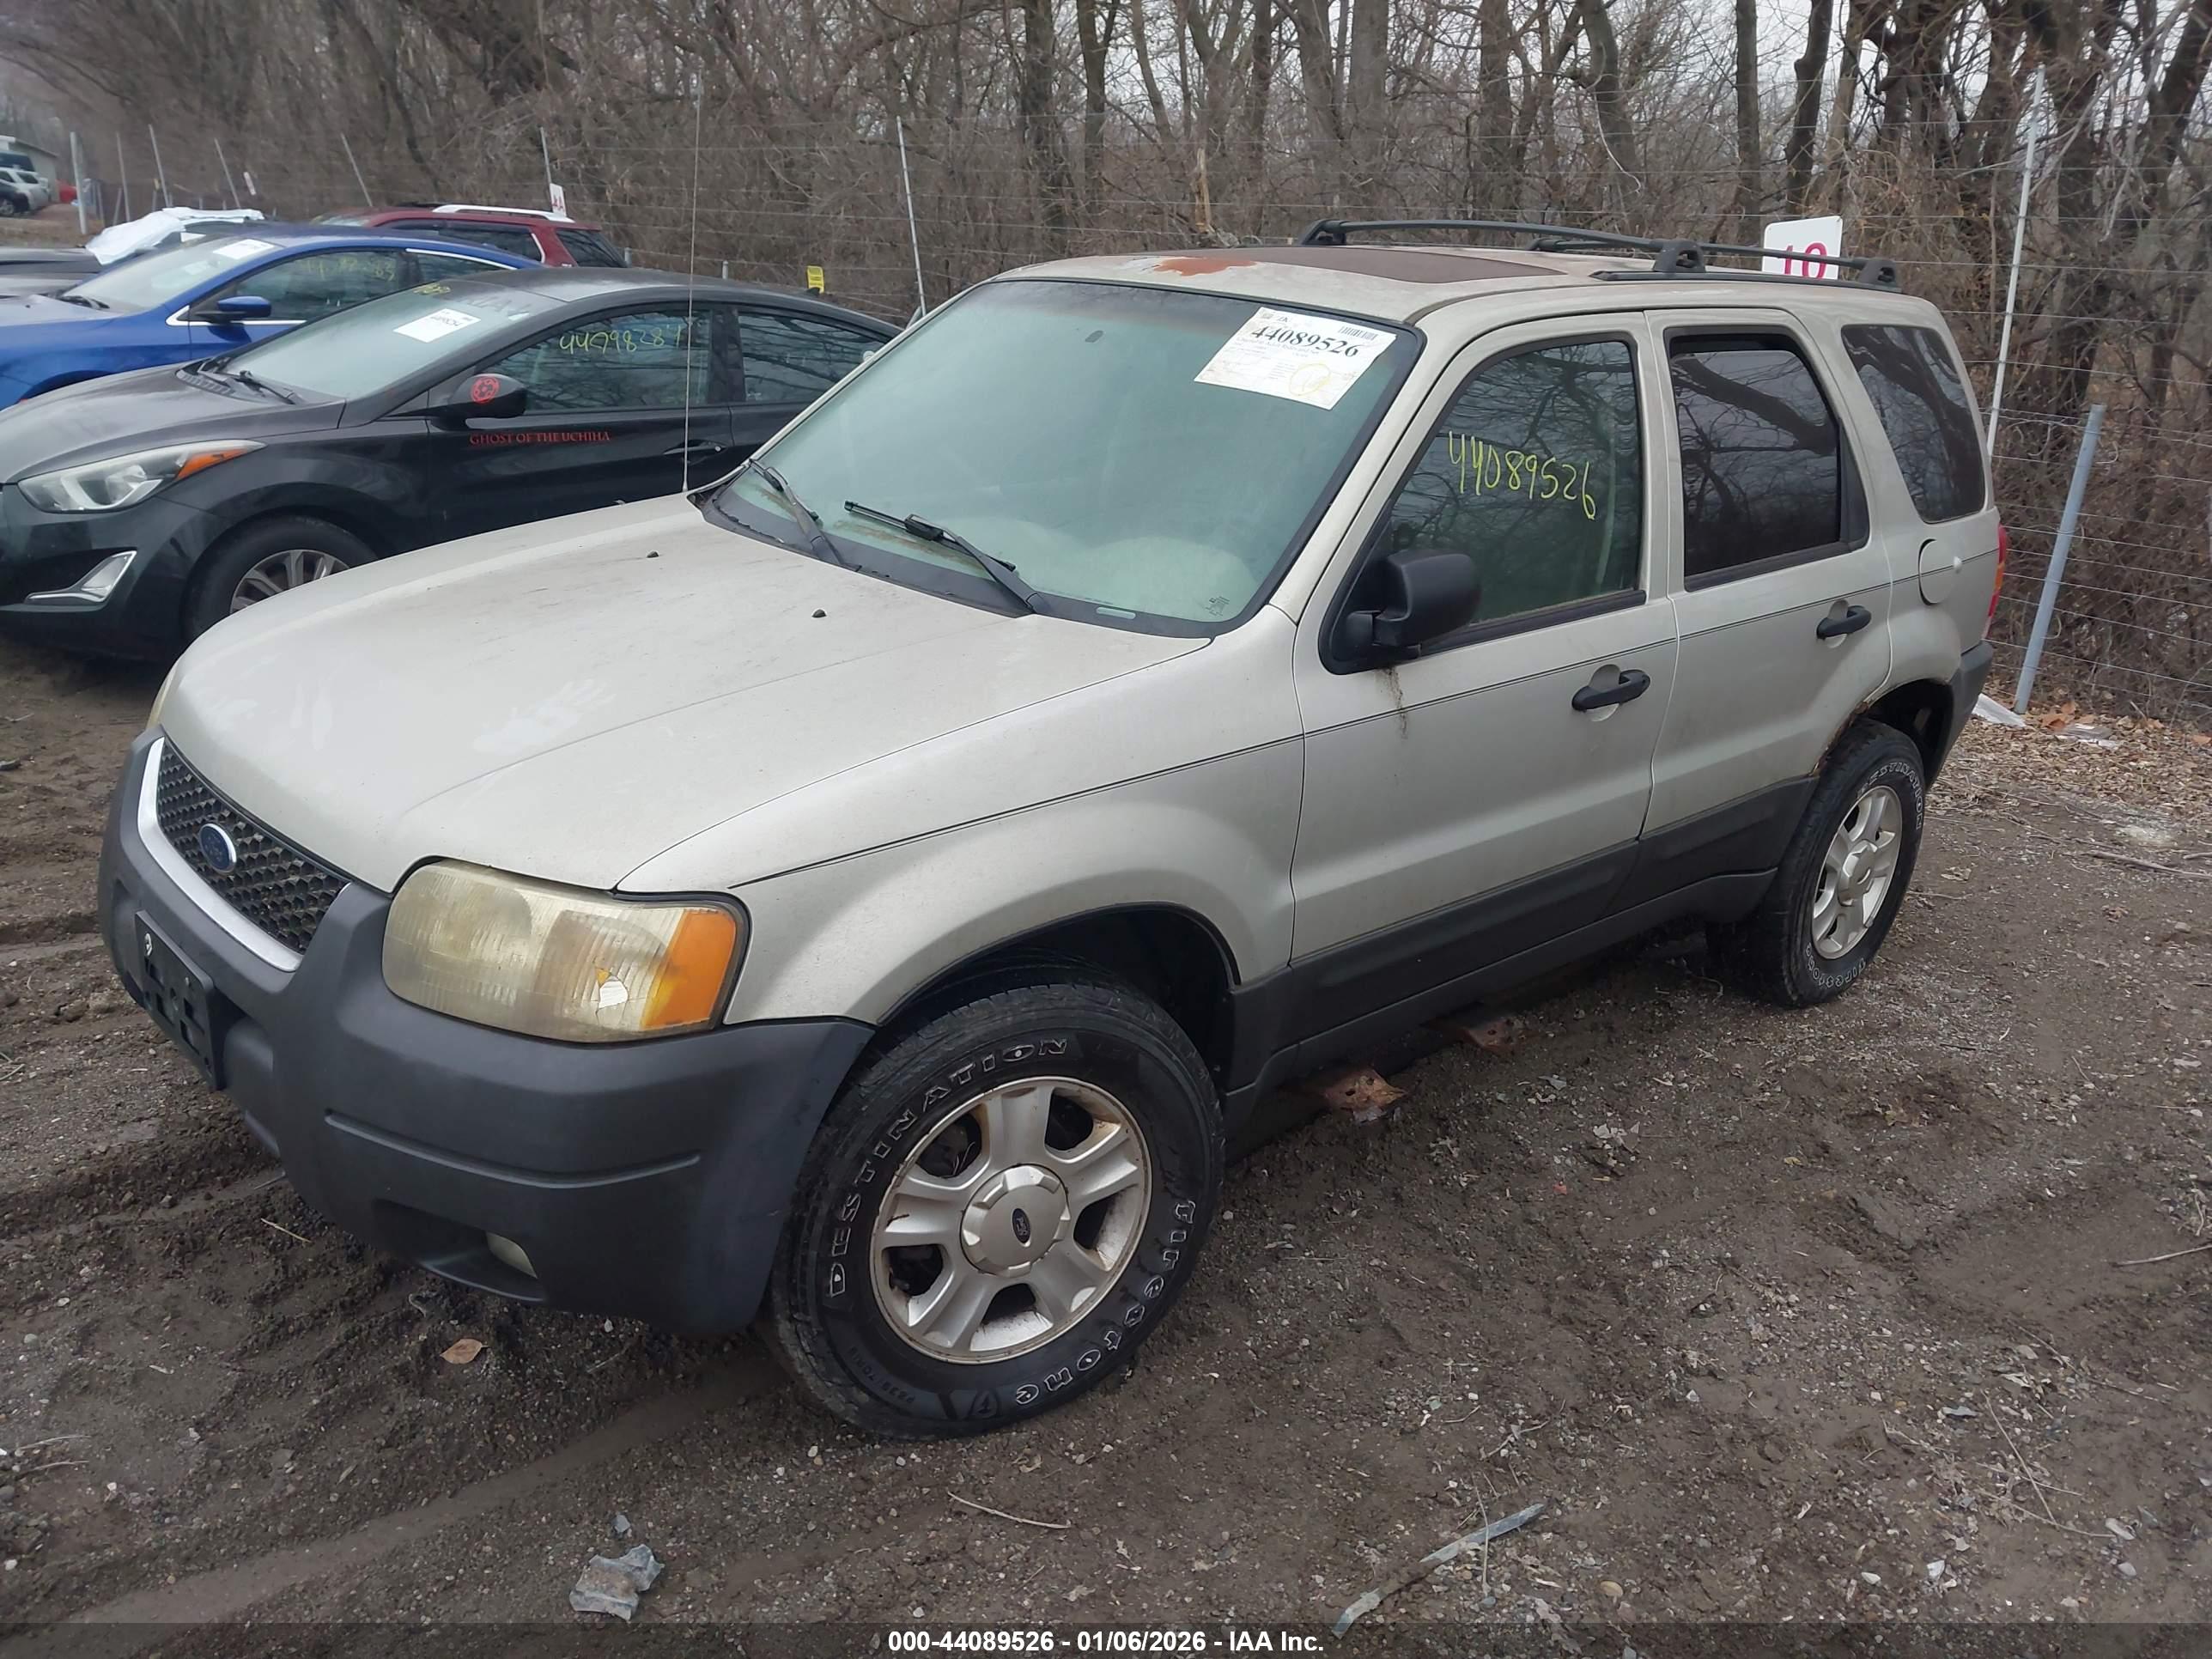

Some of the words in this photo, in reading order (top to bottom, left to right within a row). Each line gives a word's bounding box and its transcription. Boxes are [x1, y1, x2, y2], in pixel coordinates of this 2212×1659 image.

[1784, 242, 1826, 278] 10
[1251, 325, 1361, 357] 44089526
[470, 433, 513, 445] GHOST
[516, 432, 533, 444] OF
[537, 431, 558, 442] THE
[562, 431, 611, 441] UCHIHA
[1449, 430, 1597, 520] 44089526
[830, 1037, 1069, 1297] DESTINATION
